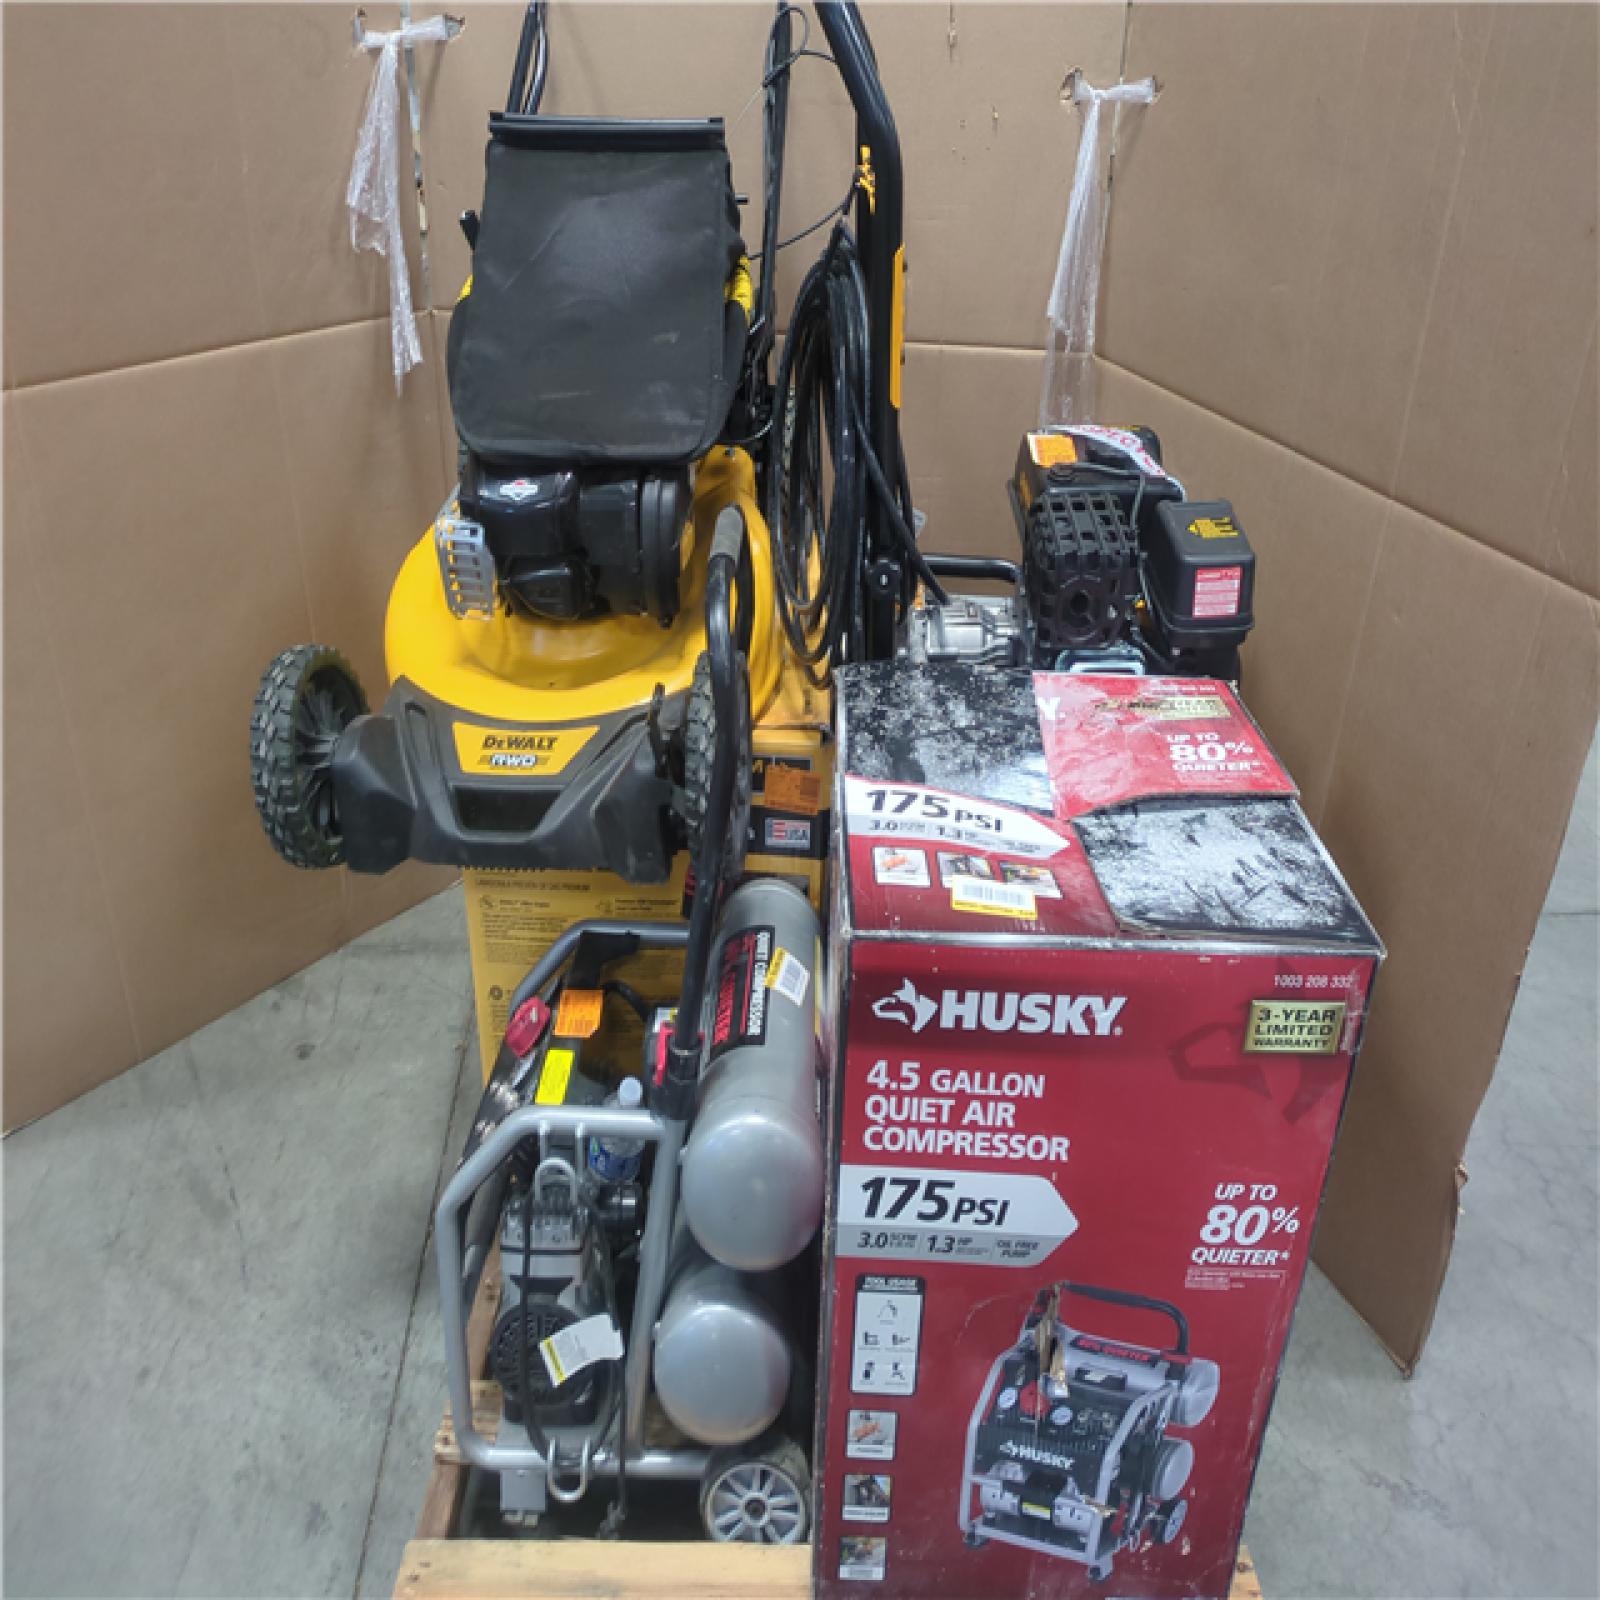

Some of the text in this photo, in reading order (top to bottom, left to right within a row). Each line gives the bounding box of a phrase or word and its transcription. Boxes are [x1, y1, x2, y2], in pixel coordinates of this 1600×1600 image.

[1166, 732, 1219, 743] UP TO
[1170, 741, 1253, 761] 80%
[1257, 1008, 1336, 1023] 3-YEAR
[1254, 1024, 1333, 1036] LIMITED
[1254, 1037, 1330, 1048] WARRANTY
[866, 1059, 1046, 1098] 4.5 GALLON
[864, 1094, 1017, 1128] QUIET AIR
[863, 1125, 1071, 1163] COMPRESSOR
[1214, 1182, 1278, 1201] UP TO
[1200, 1204, 1300, 1246] 80%
[857, 1231, 889, 1249] 3.0
[927, 1234, 956, 1254] 1.3
[1019, 1444, 1075, 1470] HUSKY
